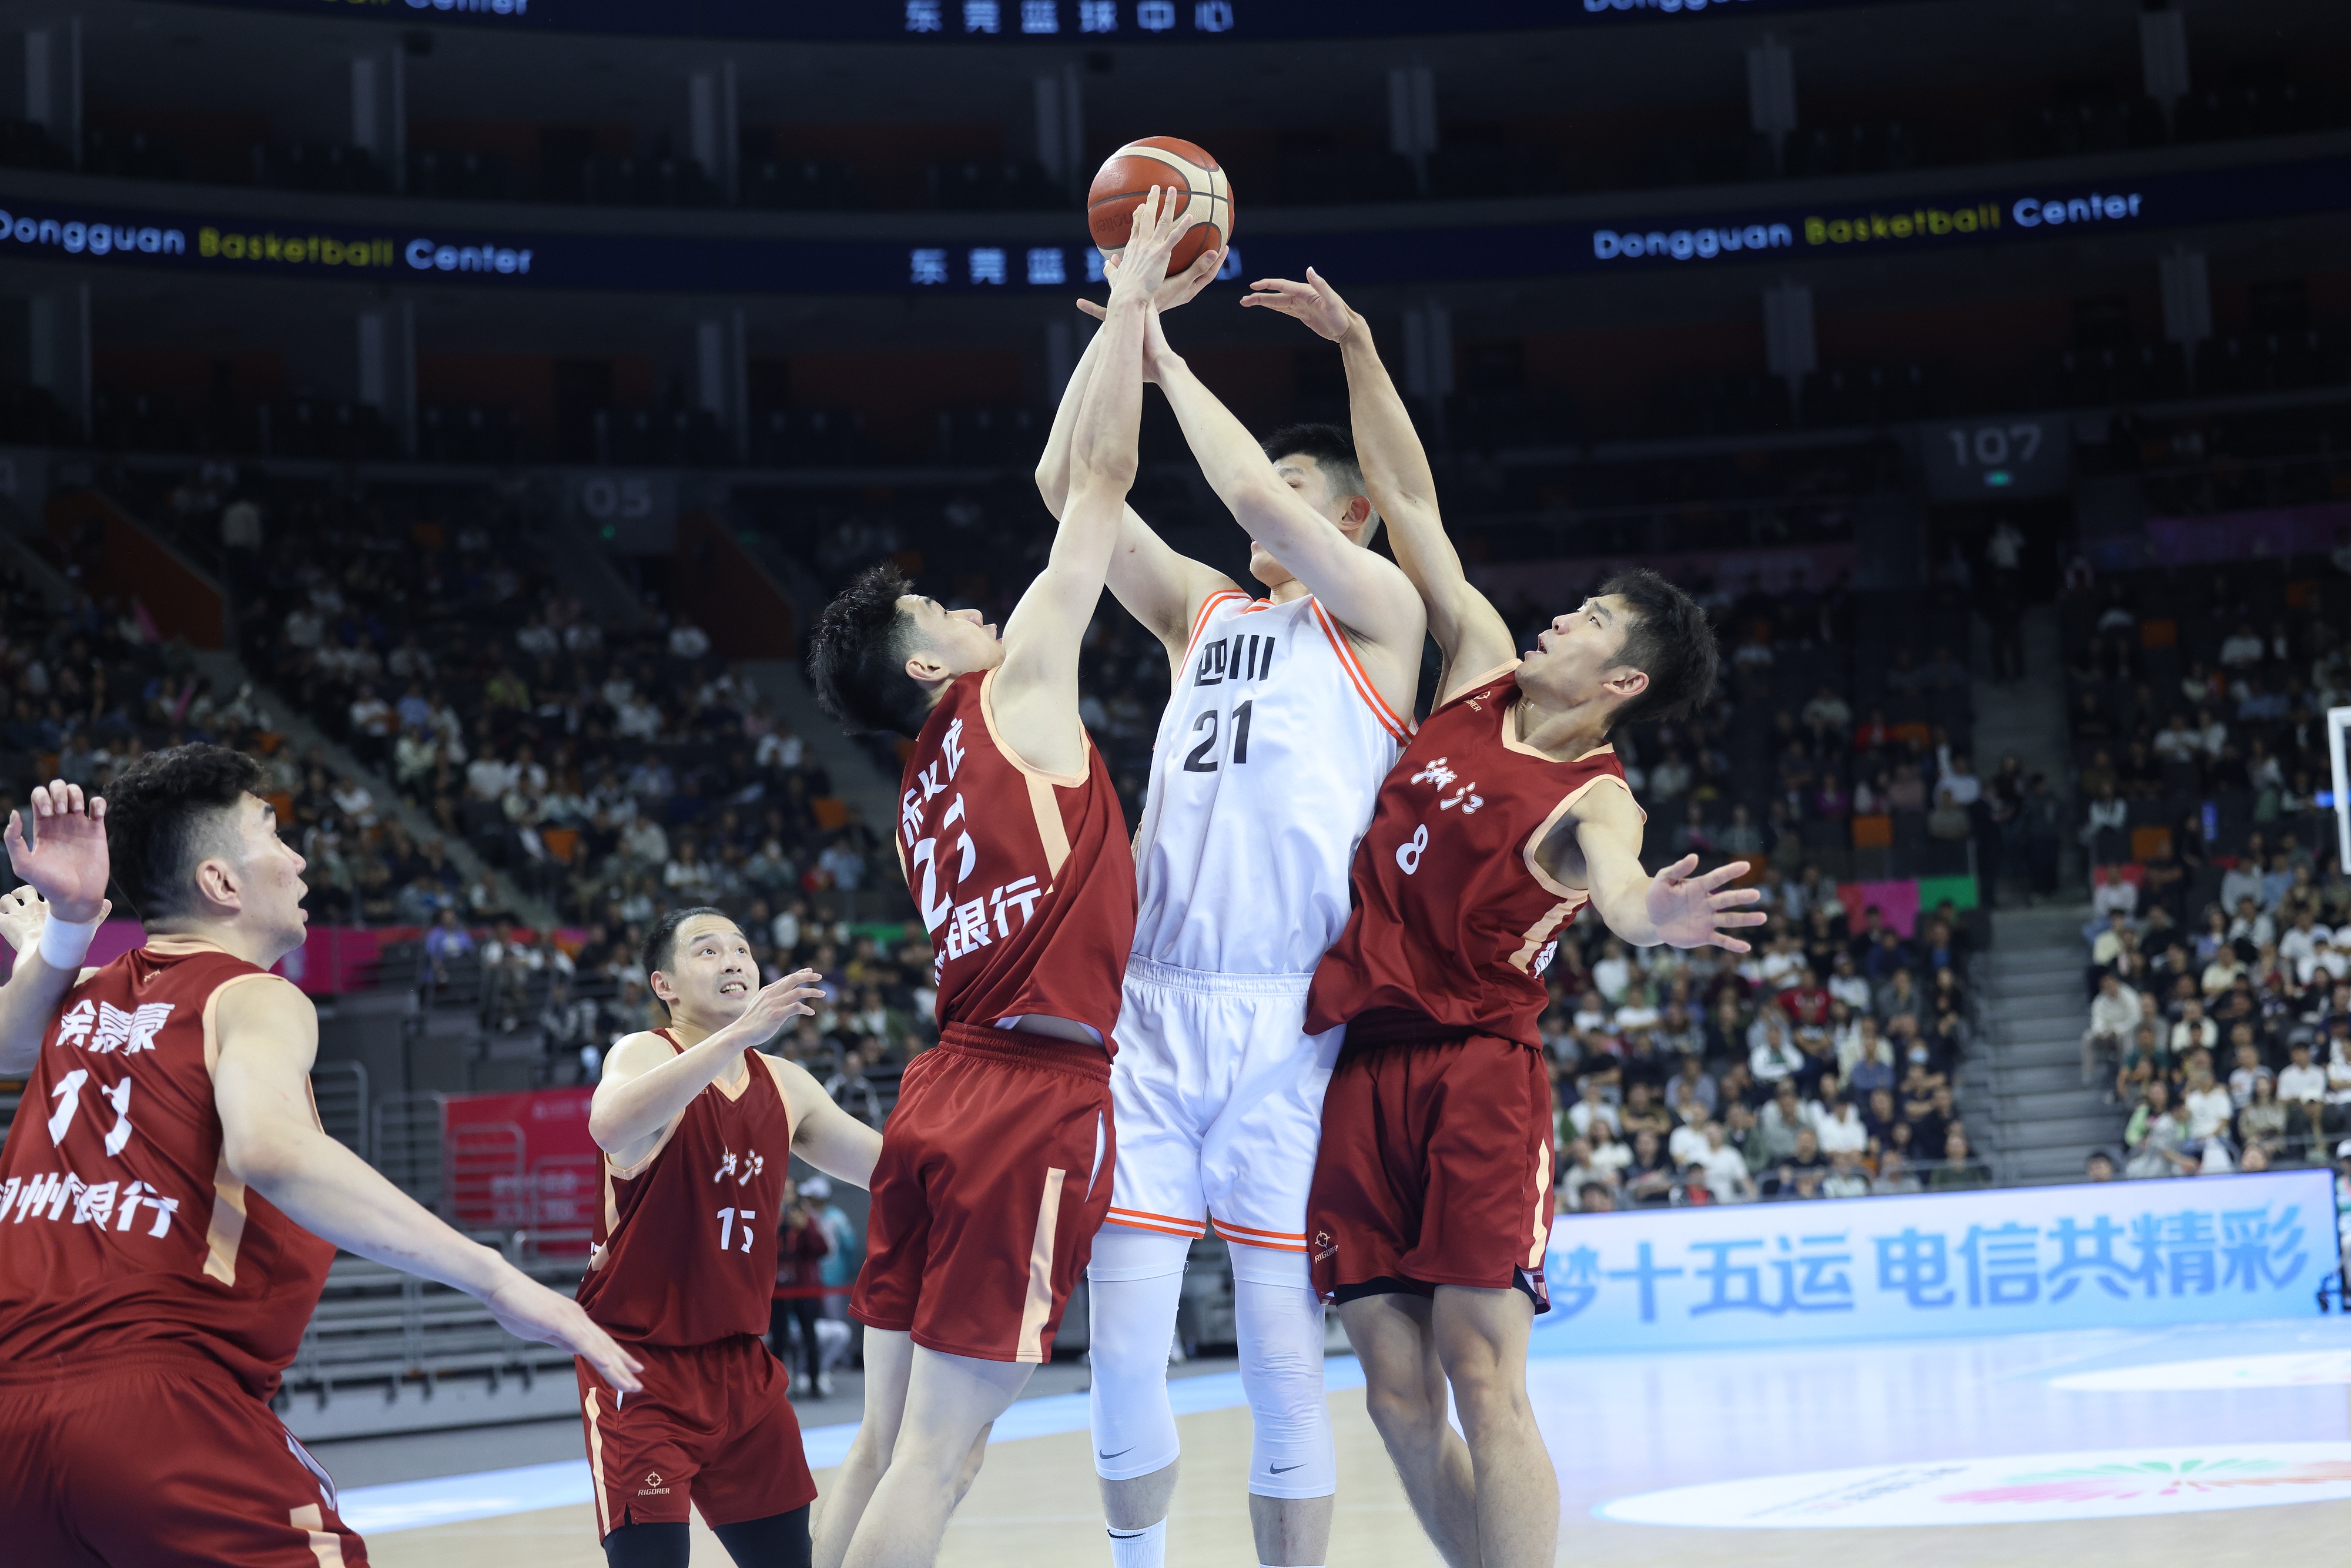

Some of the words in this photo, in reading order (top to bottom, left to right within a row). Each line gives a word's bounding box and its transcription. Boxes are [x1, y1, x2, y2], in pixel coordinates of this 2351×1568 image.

[199, 226, 393, 267] Basketball
[405, 238, 534, 274] Center
[1593, 223, 1793, 260] Dongguan
[1804, 202, 2001, 246] Basketball
[2012, 192, 2143, 227] Center
[1949, 424, 2042, 468] 107
[1194, 634, 1275, 687] 四川
[1183, 700, 1252, 772] 21
[1411, 756, 1484, 815] 浙江
[1395, 824, 1428, 875] 8
[48, 1068, 132, 1157] 11
[717, 1207, 756, 1254] 15
[1873, 1204, 2308, 1309] 电信共精彩
[637, 1487, 670, 1497] RIGORER
